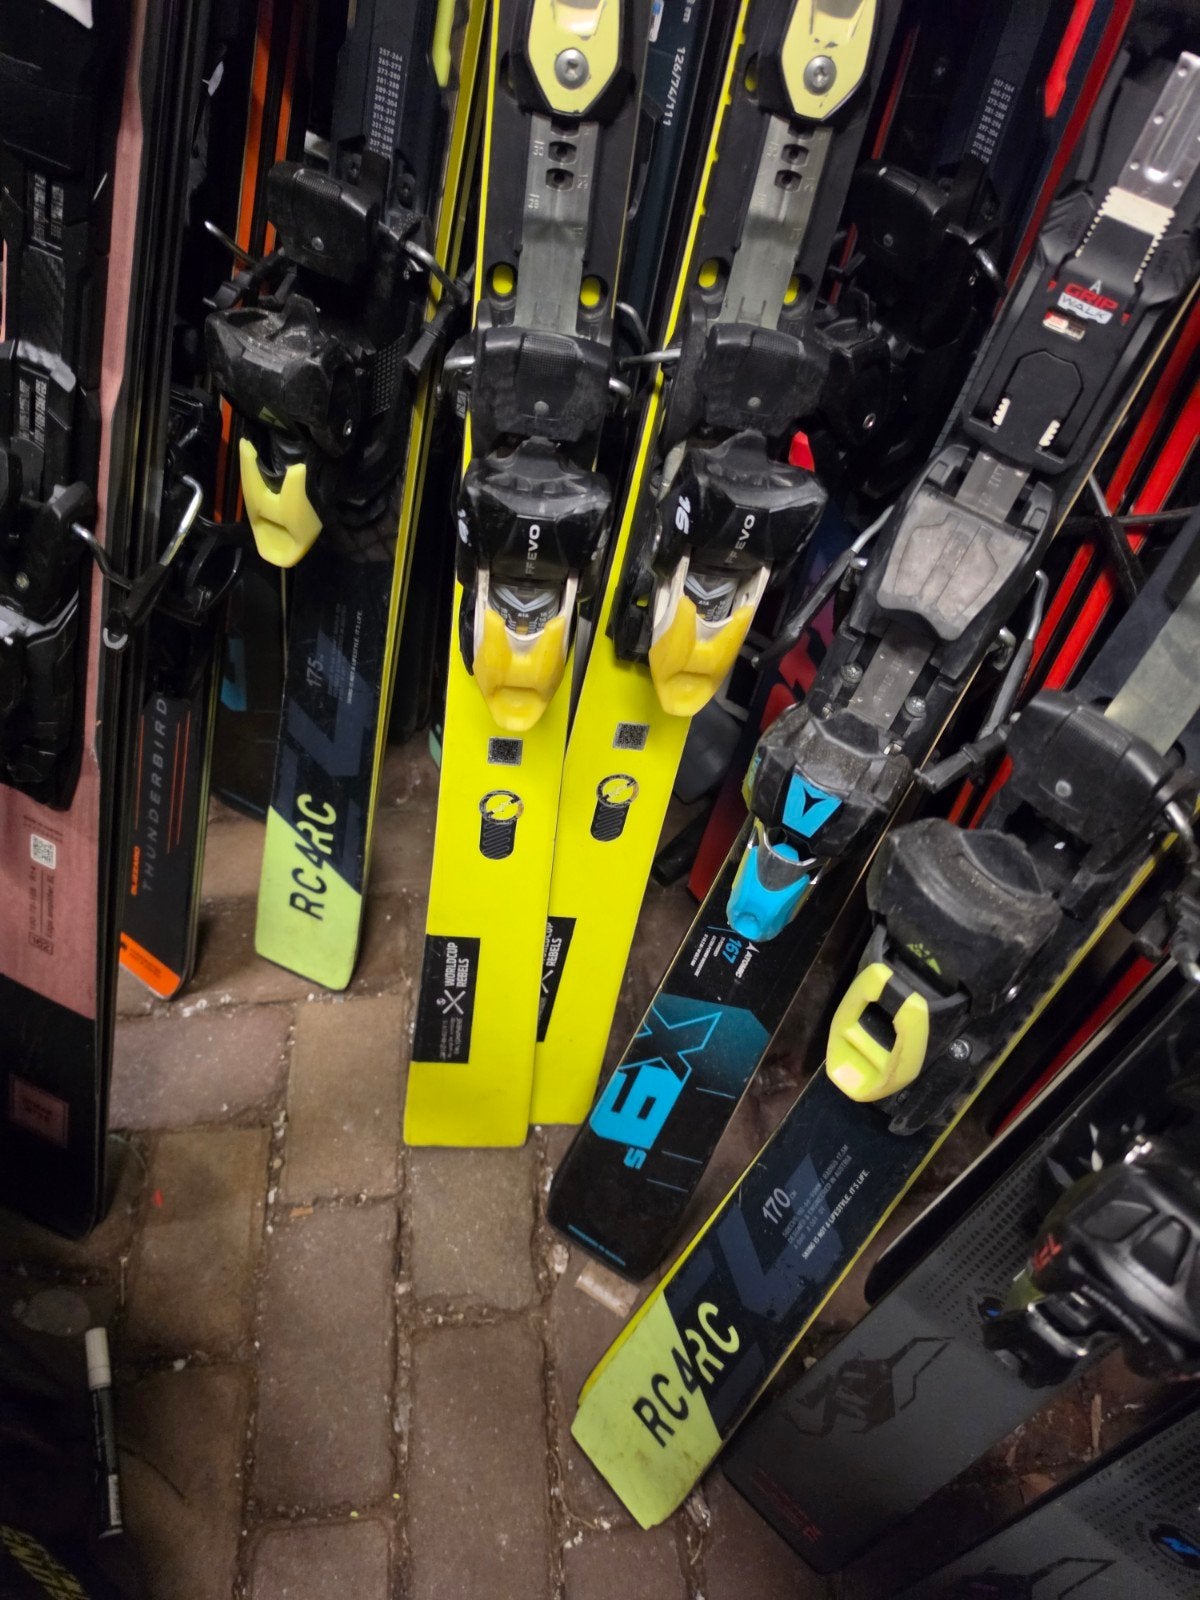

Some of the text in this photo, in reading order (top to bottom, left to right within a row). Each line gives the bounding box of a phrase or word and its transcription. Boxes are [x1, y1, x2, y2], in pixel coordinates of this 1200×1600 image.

[379, 47, 403, 62] 257-264
[376, 76, 400, 90] 281-288
[374, 93, 398, 108] 297-304
[1061, 295, 1108, 321] WALK
[1064, 282, 1119, 311] GRIP
[675, 495, 691, 535] 16
[306, 656, 324, 688] 175
[444, 942, 458, 987] WORLDCUP
[546, 937, 562, 967] REBELS
[722, 937, 743, 965] 167
[735, 950, 753, 979] ATOMIC
[456, 957, 470, 988] REBELS
[834, 1155, 851, 1177] AUSTRIA
[762, 1187, 791, 1225] 170
